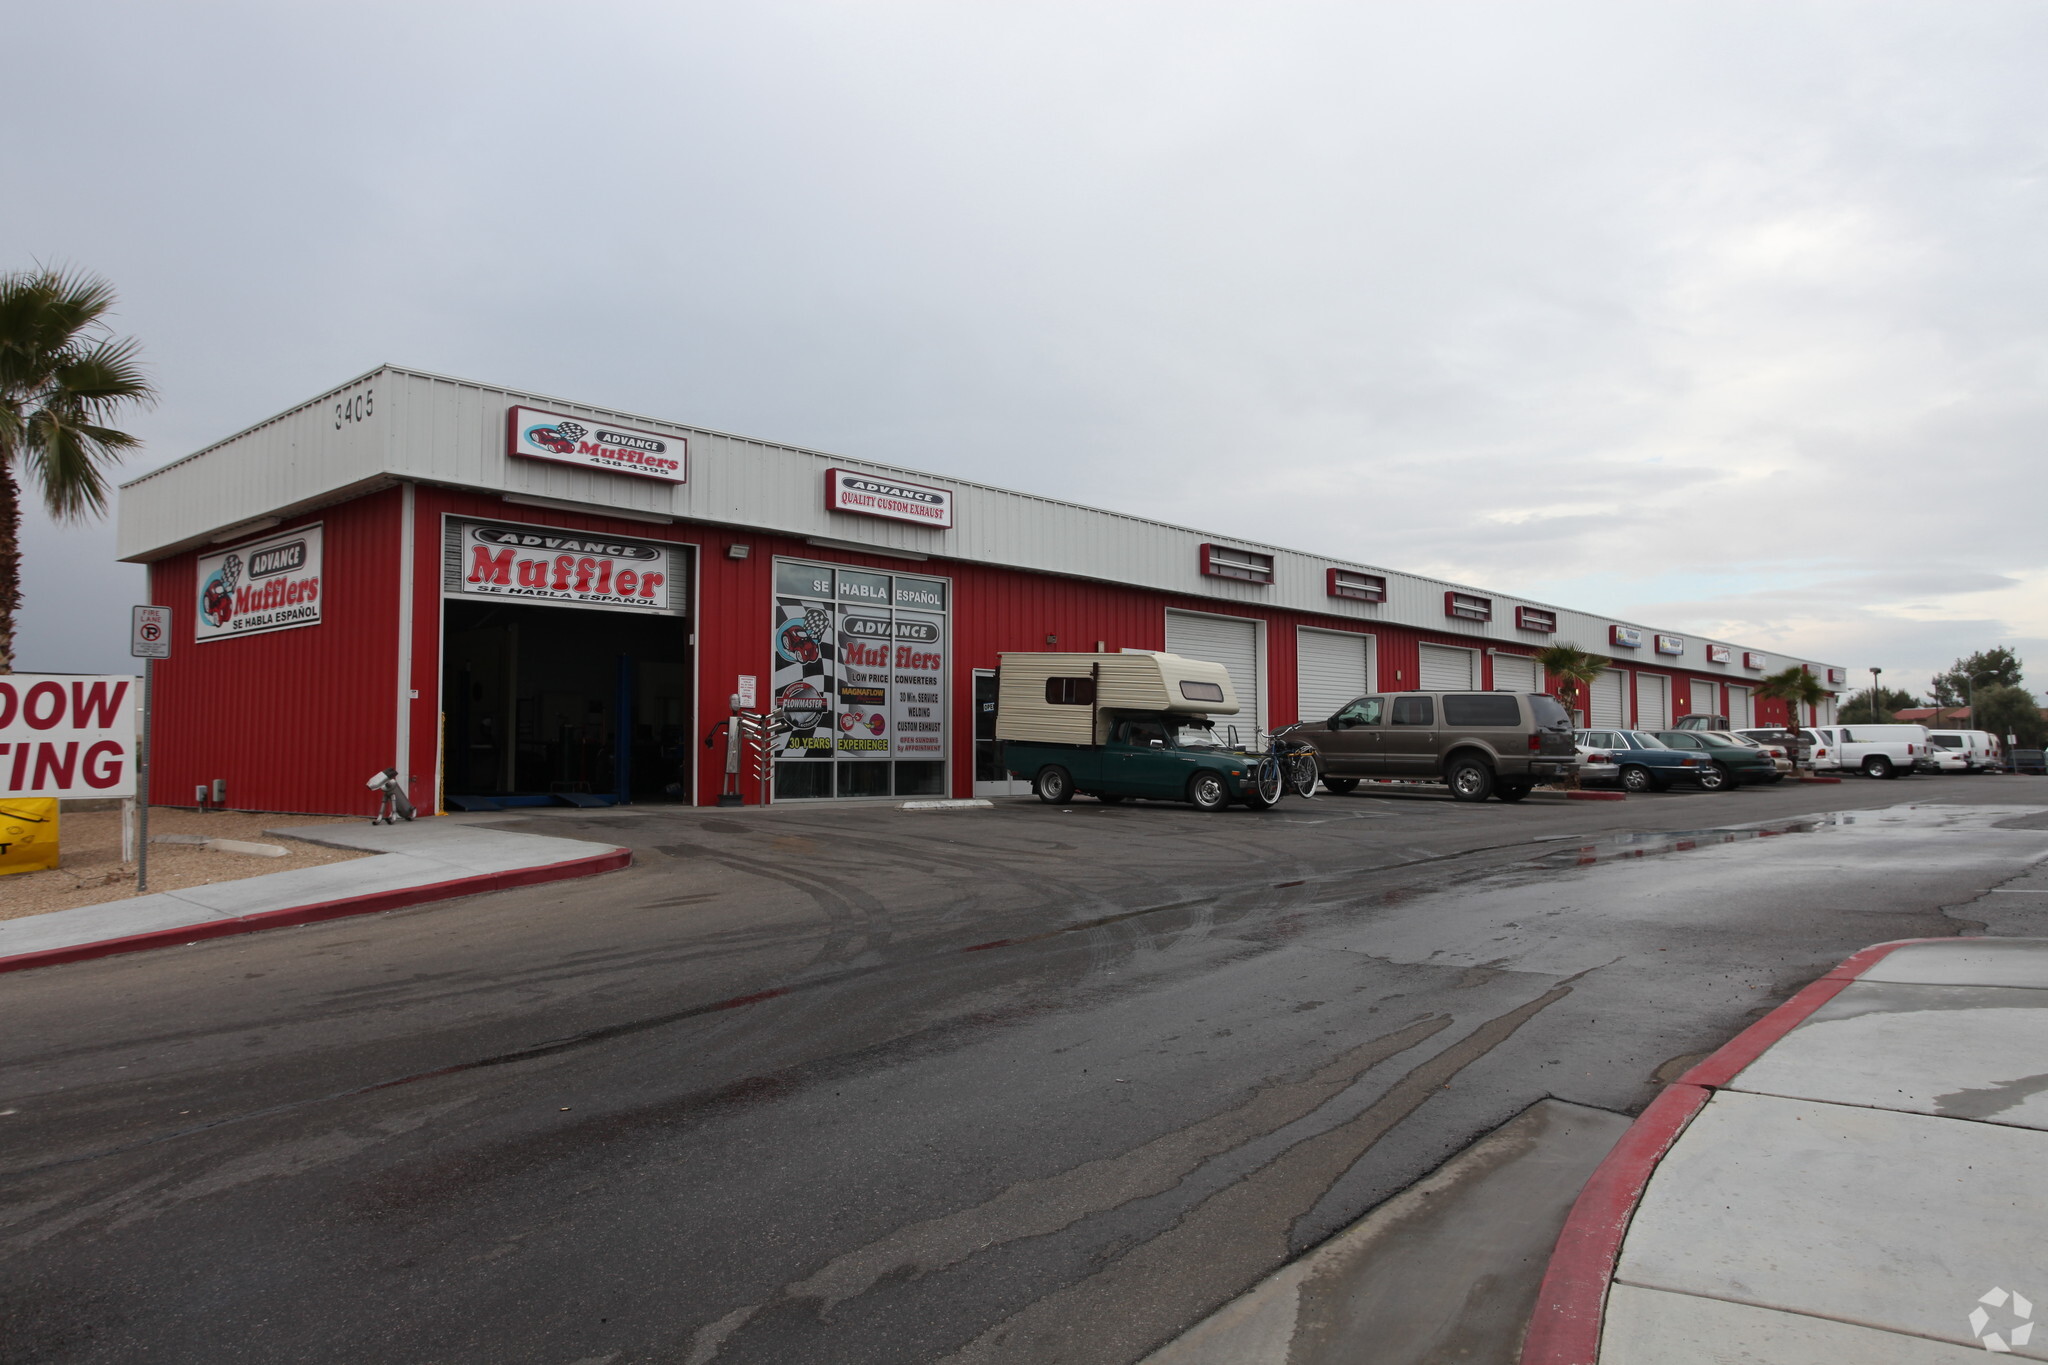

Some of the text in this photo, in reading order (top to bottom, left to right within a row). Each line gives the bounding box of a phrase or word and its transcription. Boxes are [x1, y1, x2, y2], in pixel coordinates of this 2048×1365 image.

[335, 389, 373, 430] 3405
[603, 434, 658, 450] ADVANCE
[577, 441, 679, 470] Mufflers
[590, 457, 669, 475] 438-4395
[852, 481, 933, 502] ADVANCE
[841, 491, 944, 519] QUALITY CUSTOM EXHAUST
[497, 533, 638, 557] ADVANCE
[253, 546, 300, 574] ADVANCE
[466, 544, 666, 599] Muffler
[233, 576, 319, 616] Mufflers
[508, 588, 572, 598] HABLA
[813, 580, 941, 605] SE HABLA ESPAÑOL
[142, 609, 160, 617] FIRE
[232, 605, 318, 629] SE HABLA ESPAÑOL
[853, 621, 928, 638] ADVANCE
[852, 673, 938, 686] LOW PRICE CONVERTERS
[841, 687, 884, 696] MAGNAFLOW
[783, 699, 823, 710] FLOWMASTER
[897, 722, 941, 732] CUSTOM EXHAUST
[789, 737, 889, 751] 30 YEARS EXPERIENCE
